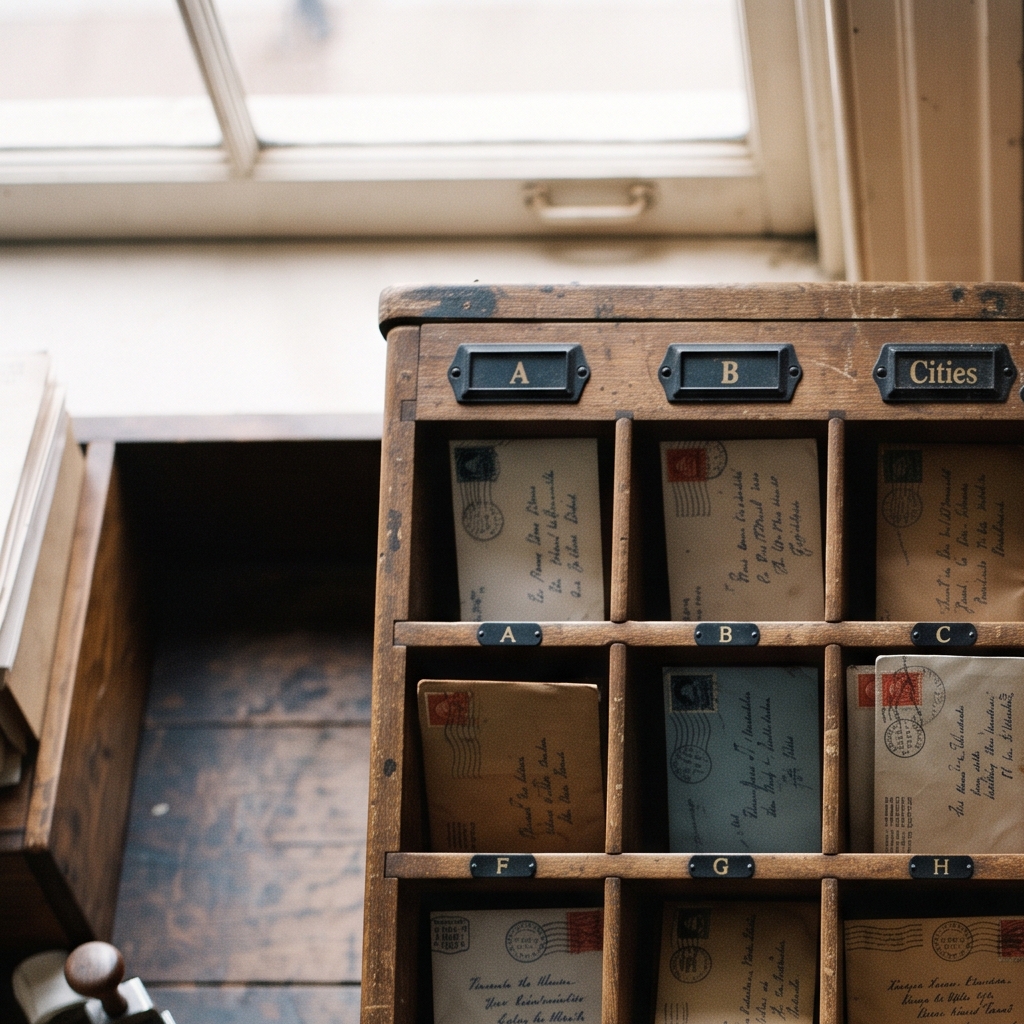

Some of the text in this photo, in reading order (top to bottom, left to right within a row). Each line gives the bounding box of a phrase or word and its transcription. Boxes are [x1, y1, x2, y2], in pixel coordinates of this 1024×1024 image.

[509, 361, 530, 385] A
[720, 360, 740, 385] B
[909, 360, 978, 385] Cities
[499, 625, 517, 643] A
[718, 625, 733, 643] B
[935, 625, 951, 644] C
[496, 857, 510, 875] F
[712, 857, 729, 876] G
[933, 858, 949, 876] H
